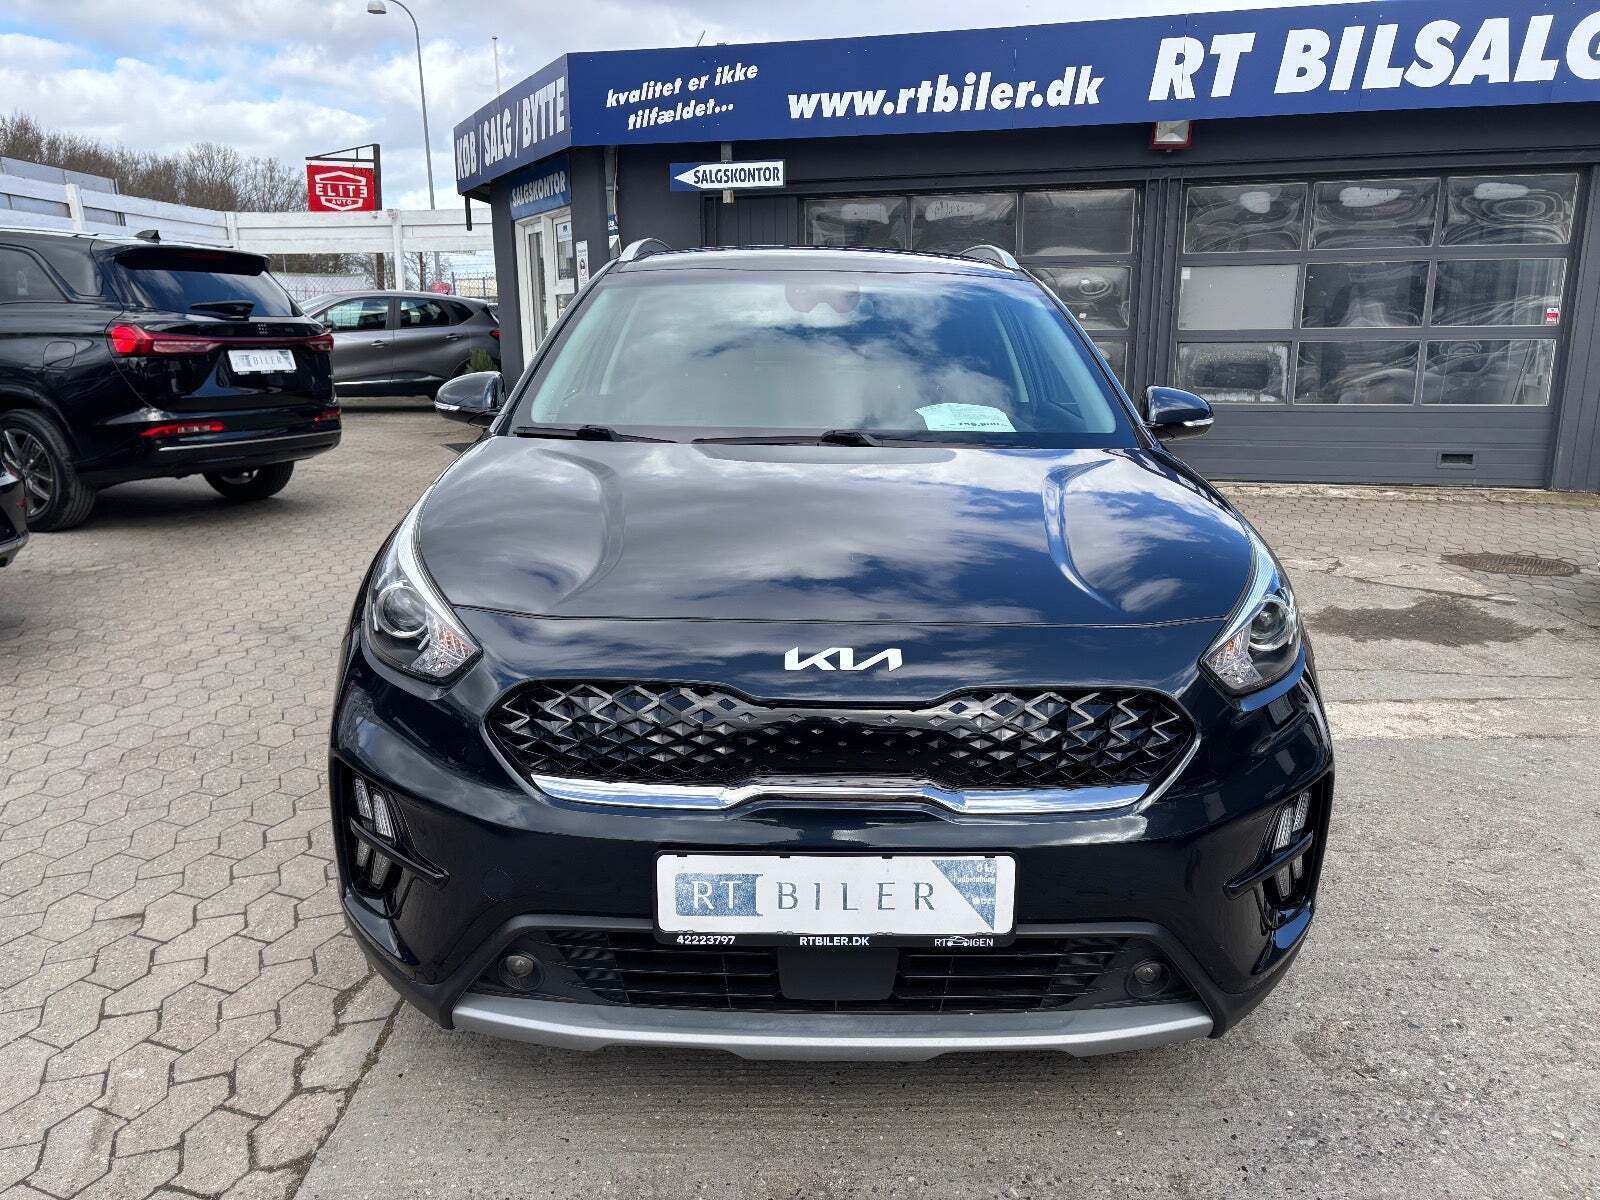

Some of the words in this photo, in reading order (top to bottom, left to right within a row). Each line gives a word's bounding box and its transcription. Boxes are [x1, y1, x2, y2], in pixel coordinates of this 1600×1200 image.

[1148, 31, 1256, 101] RT
[606, 77, 683, 108] kvalitet
[688, 74, 709, 92] er
[714, 62, 758, 86] ikke
[787, 65, 1105, 119] www.rtbiler.dk
[456, 131, 477, 181] KØB
[483, 107, 512, 167] SALG
[522, 76, 565, 149] BYTTE
[627, 98, 734, 131] tilfældet...
[315, 183, 368, 198] ELITE
[511, 170, 566, 208] SALGSKONTOR
[693, 165, 780, 185] SALGSKONTOR
[692, 880, 743, 911] RT
[776, 881, 936, 911] BILER
[676, 935, 736, 946] 42223797
[799, 937, 870, 947] RTBILER.DK
